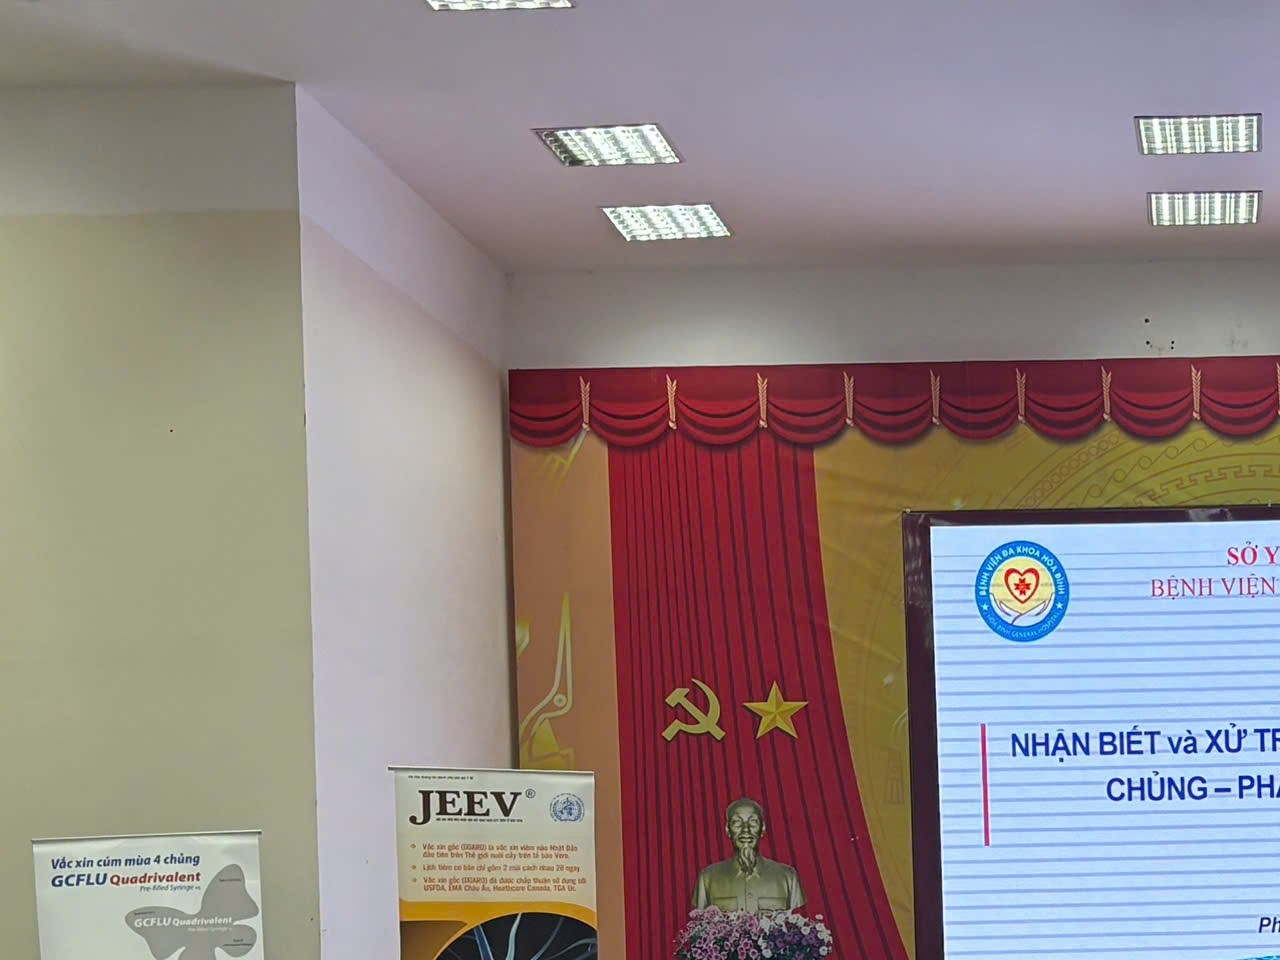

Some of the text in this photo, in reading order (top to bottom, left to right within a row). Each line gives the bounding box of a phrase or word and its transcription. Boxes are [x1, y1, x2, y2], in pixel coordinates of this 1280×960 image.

[1016, 545, 1041, 558] KHOA
[1227, 540, 1258, 566] SỞ
[1264, 545, 1280, 565] Y
[1151, 575, 1213, 600] BỆNH
[1221, 573, 1276, 599] VIỆN
[1011, 729, 1090, 763] NHẬN
[1099, 725, 1161, 756] BIẾT
[1167, 730, 1198, 754] và
[1205, 723, 1248, 754] XỬ
[1106, 771, 1208, 801] CHỦNG
[409, 789, 522, 826] JEEV
[51, 852, 201, 869] Vắc xin cúm mùa 4 chủng
[51, 871, 201, 888] GCFLU Quadrivalent
[134, 915, 233, 928] GCFLU Quadrivalent
